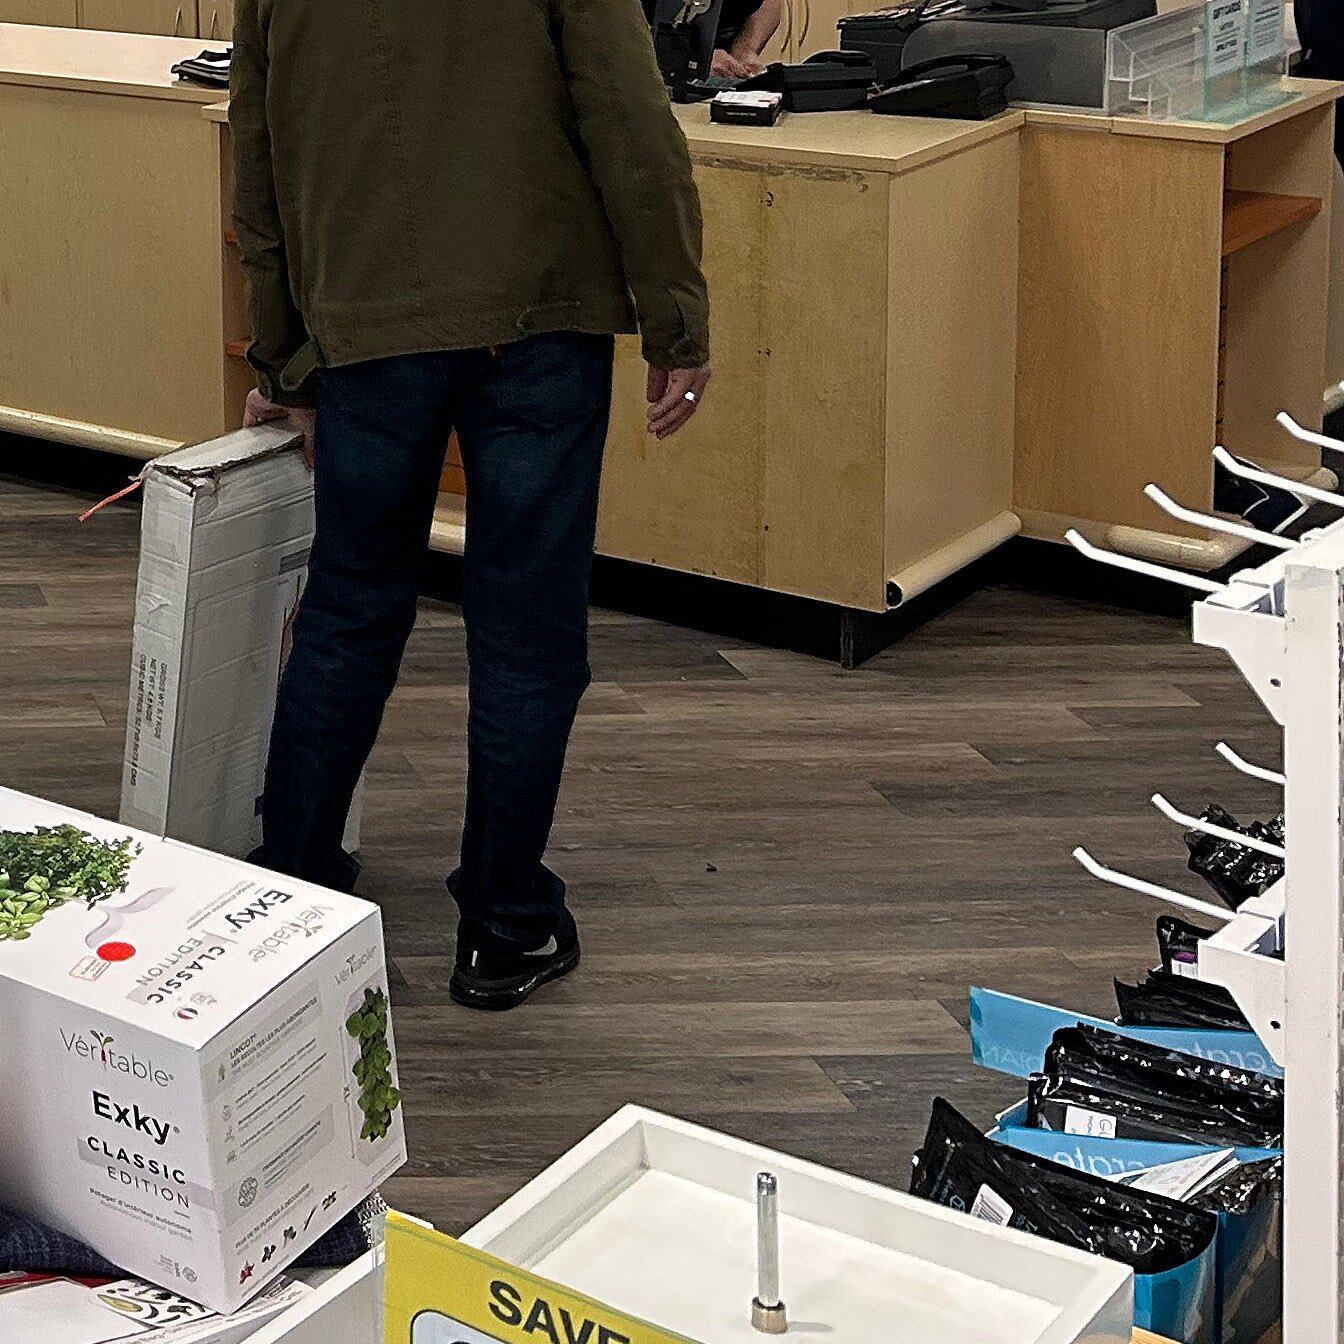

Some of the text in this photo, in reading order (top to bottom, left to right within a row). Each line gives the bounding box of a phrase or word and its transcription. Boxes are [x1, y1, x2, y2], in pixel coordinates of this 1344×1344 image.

[224, 889, 294, 930] Exky
[136, 937, 203, 986] EDITION
[147, 945, 226, 1004] CLASSIC
[59, 1027, 172, 1087] Véritable
[92, 1090, 170, 1146] Exky
[87, 1136, 186, 1185] CLASSIC
[107, 1165, 190, 1209] EDITION
